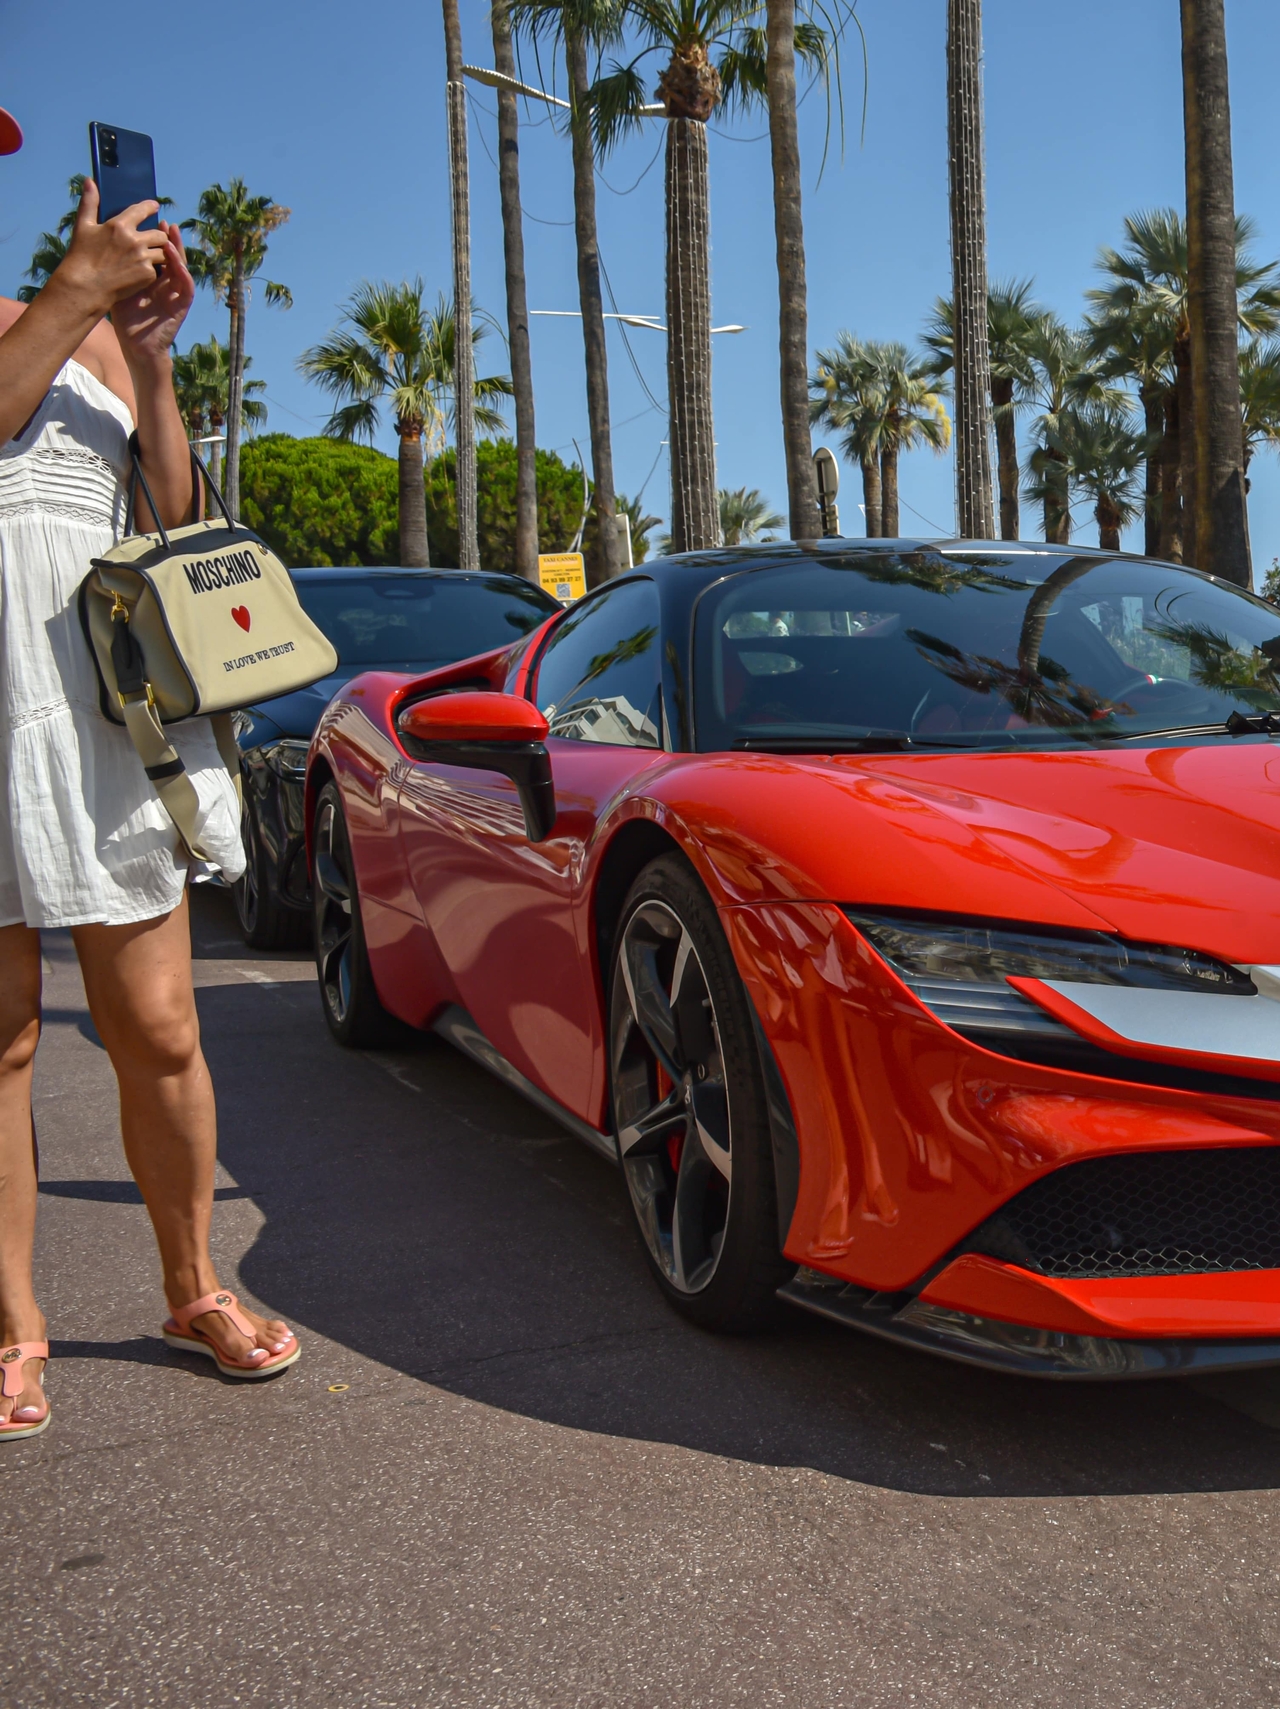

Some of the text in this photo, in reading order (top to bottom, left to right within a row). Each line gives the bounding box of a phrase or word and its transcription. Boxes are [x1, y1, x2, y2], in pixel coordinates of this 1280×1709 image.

[182, 549, 262, 595] MOSCHINO
[223, 641, 295, 672] IN LOVE WE TRUST
